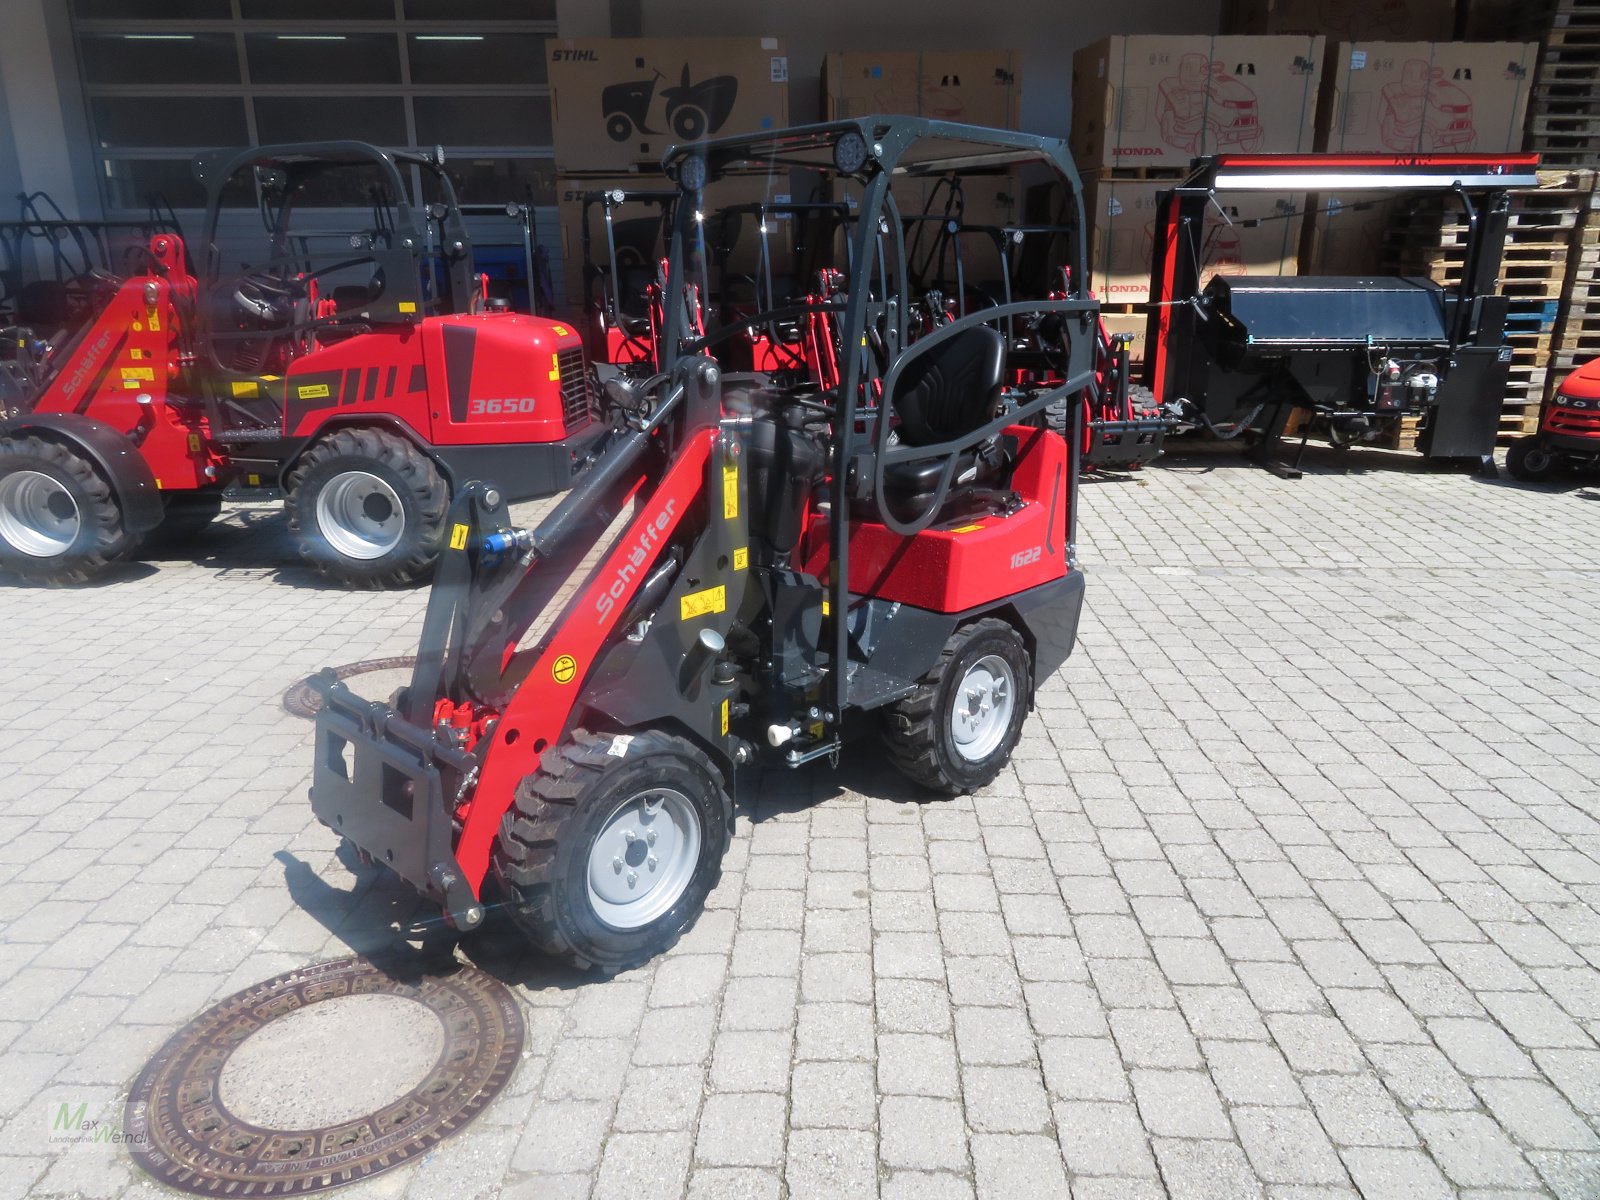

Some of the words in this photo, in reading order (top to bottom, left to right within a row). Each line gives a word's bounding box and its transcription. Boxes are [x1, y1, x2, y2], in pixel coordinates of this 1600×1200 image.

[552, 50, 599, 61] STIHL
[1111, 148, 1164, 156] HONDA
[62, 330, 111, 401] Schäffer
[471, 398, 535, 414] 3650
[596, 498, 676, 625] Schäffer
[1010, 546, 1042, 570] 1622
